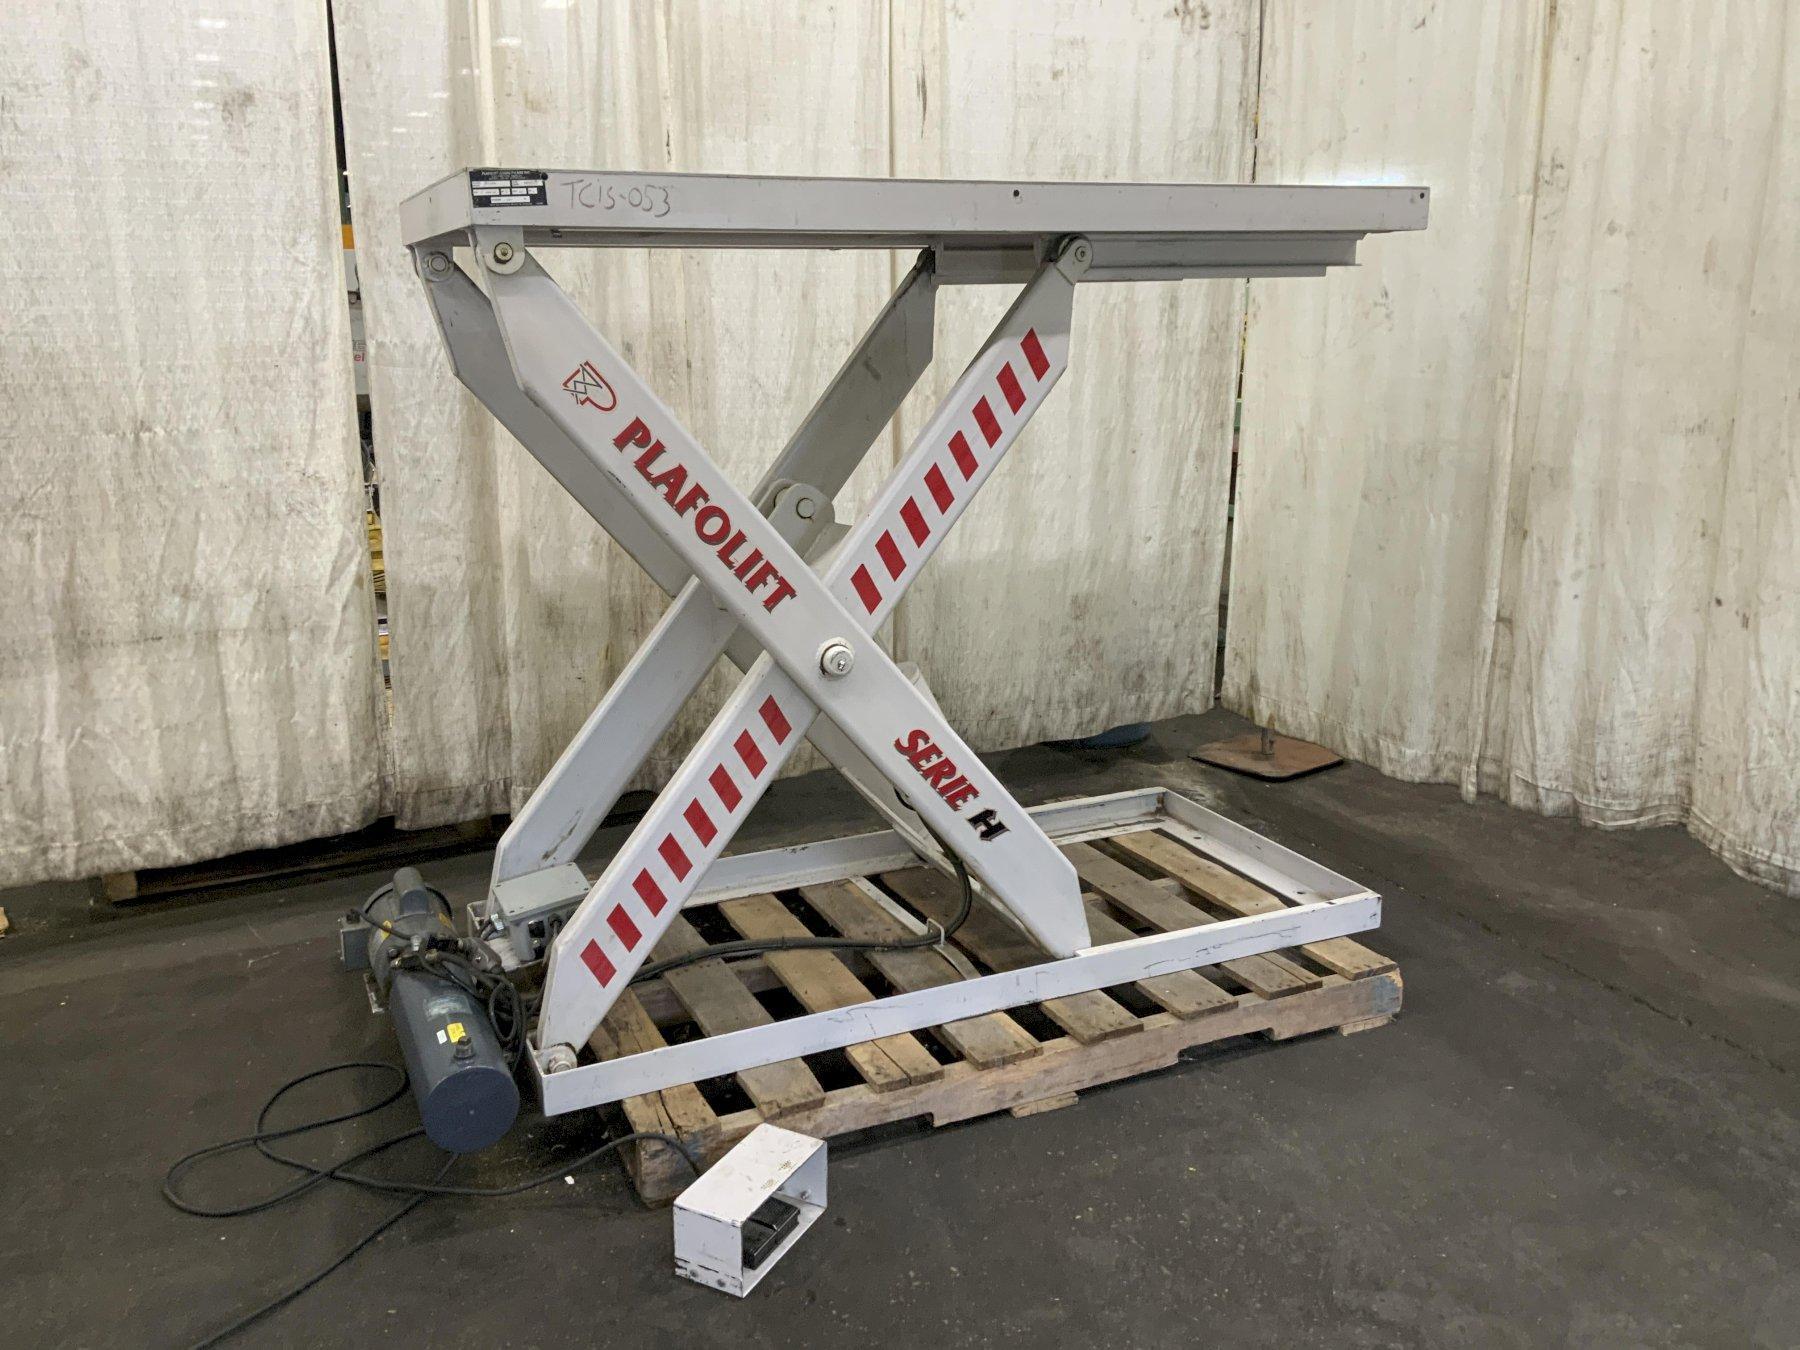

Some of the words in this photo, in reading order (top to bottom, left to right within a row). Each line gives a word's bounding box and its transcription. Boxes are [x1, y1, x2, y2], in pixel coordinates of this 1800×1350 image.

[612, 416, 798, 614] PLAFOLIFT
[893, 729, 980, 812] SERIE
[965, 808, 1011, 842] H
